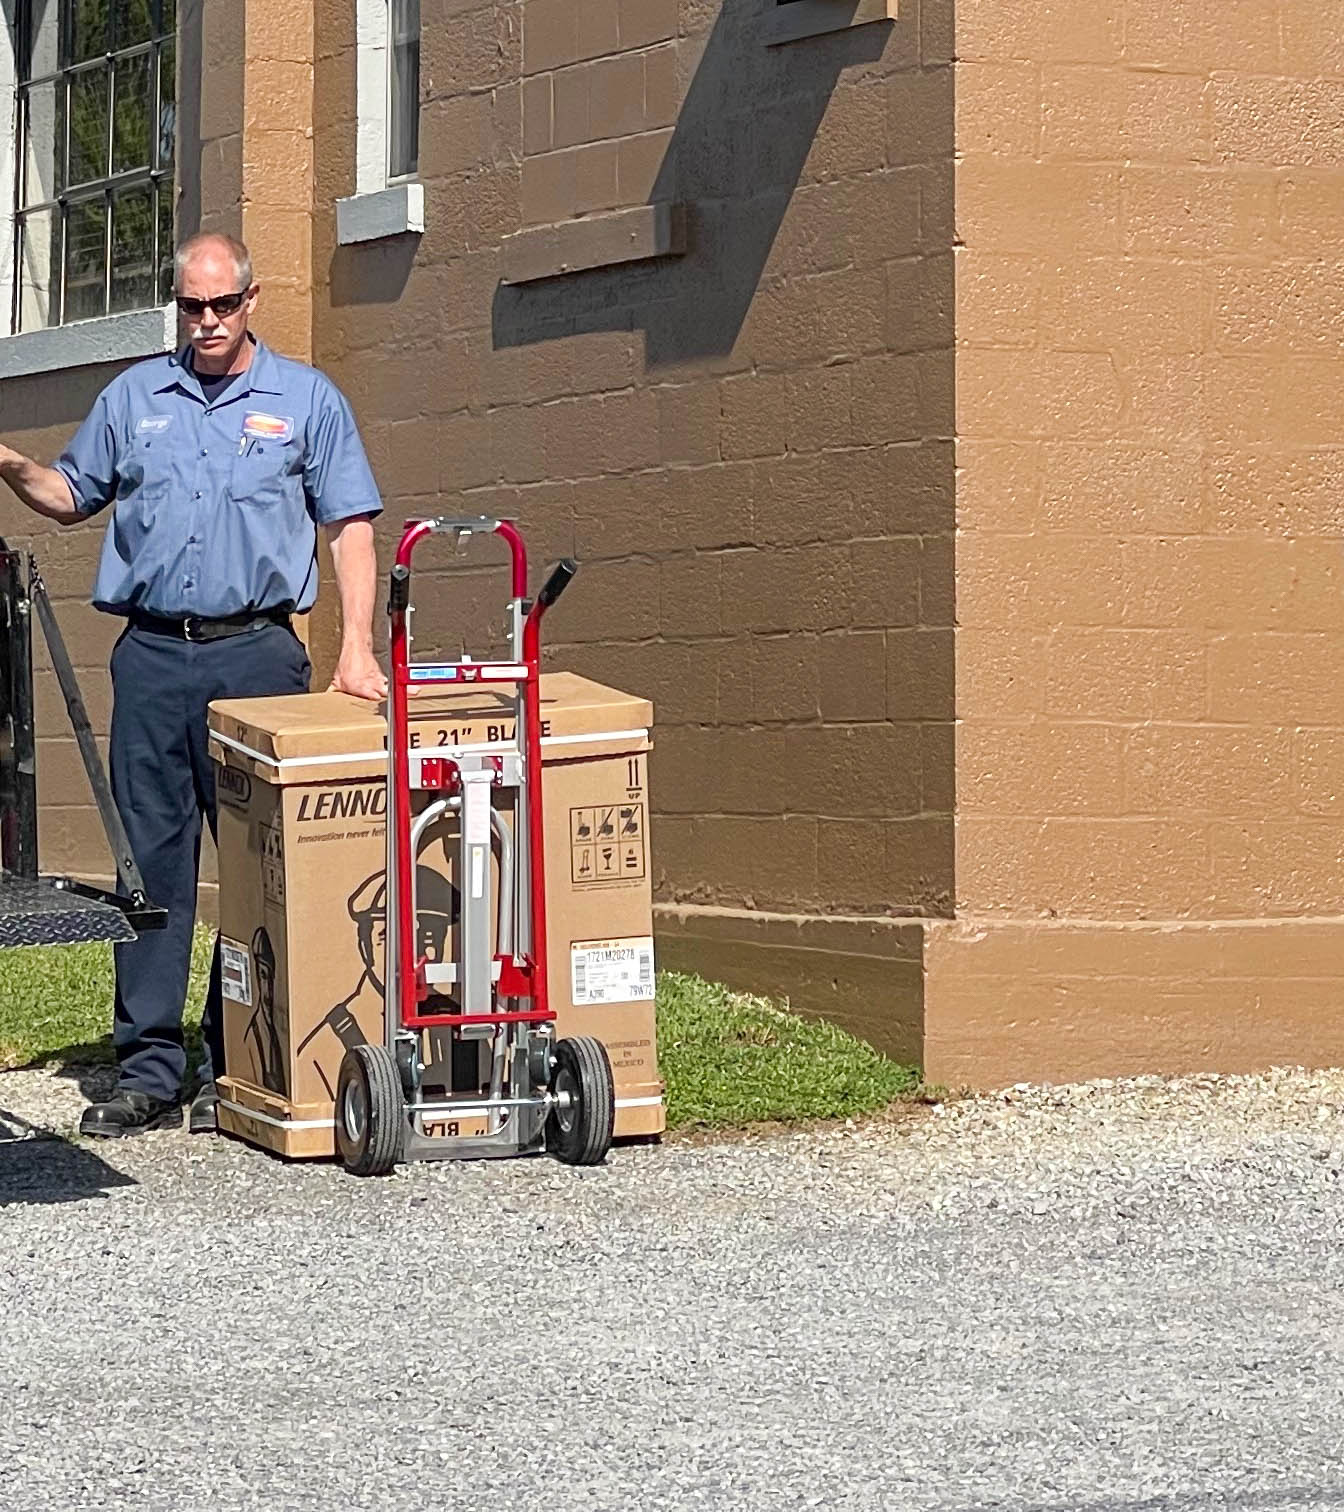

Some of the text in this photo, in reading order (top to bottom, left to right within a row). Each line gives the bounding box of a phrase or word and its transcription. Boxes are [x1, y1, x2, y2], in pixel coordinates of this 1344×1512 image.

[437, 727, 472, 747] 21"
[296, 787, 387, 822] LENNO
[628, 792, 641, 800] UP
